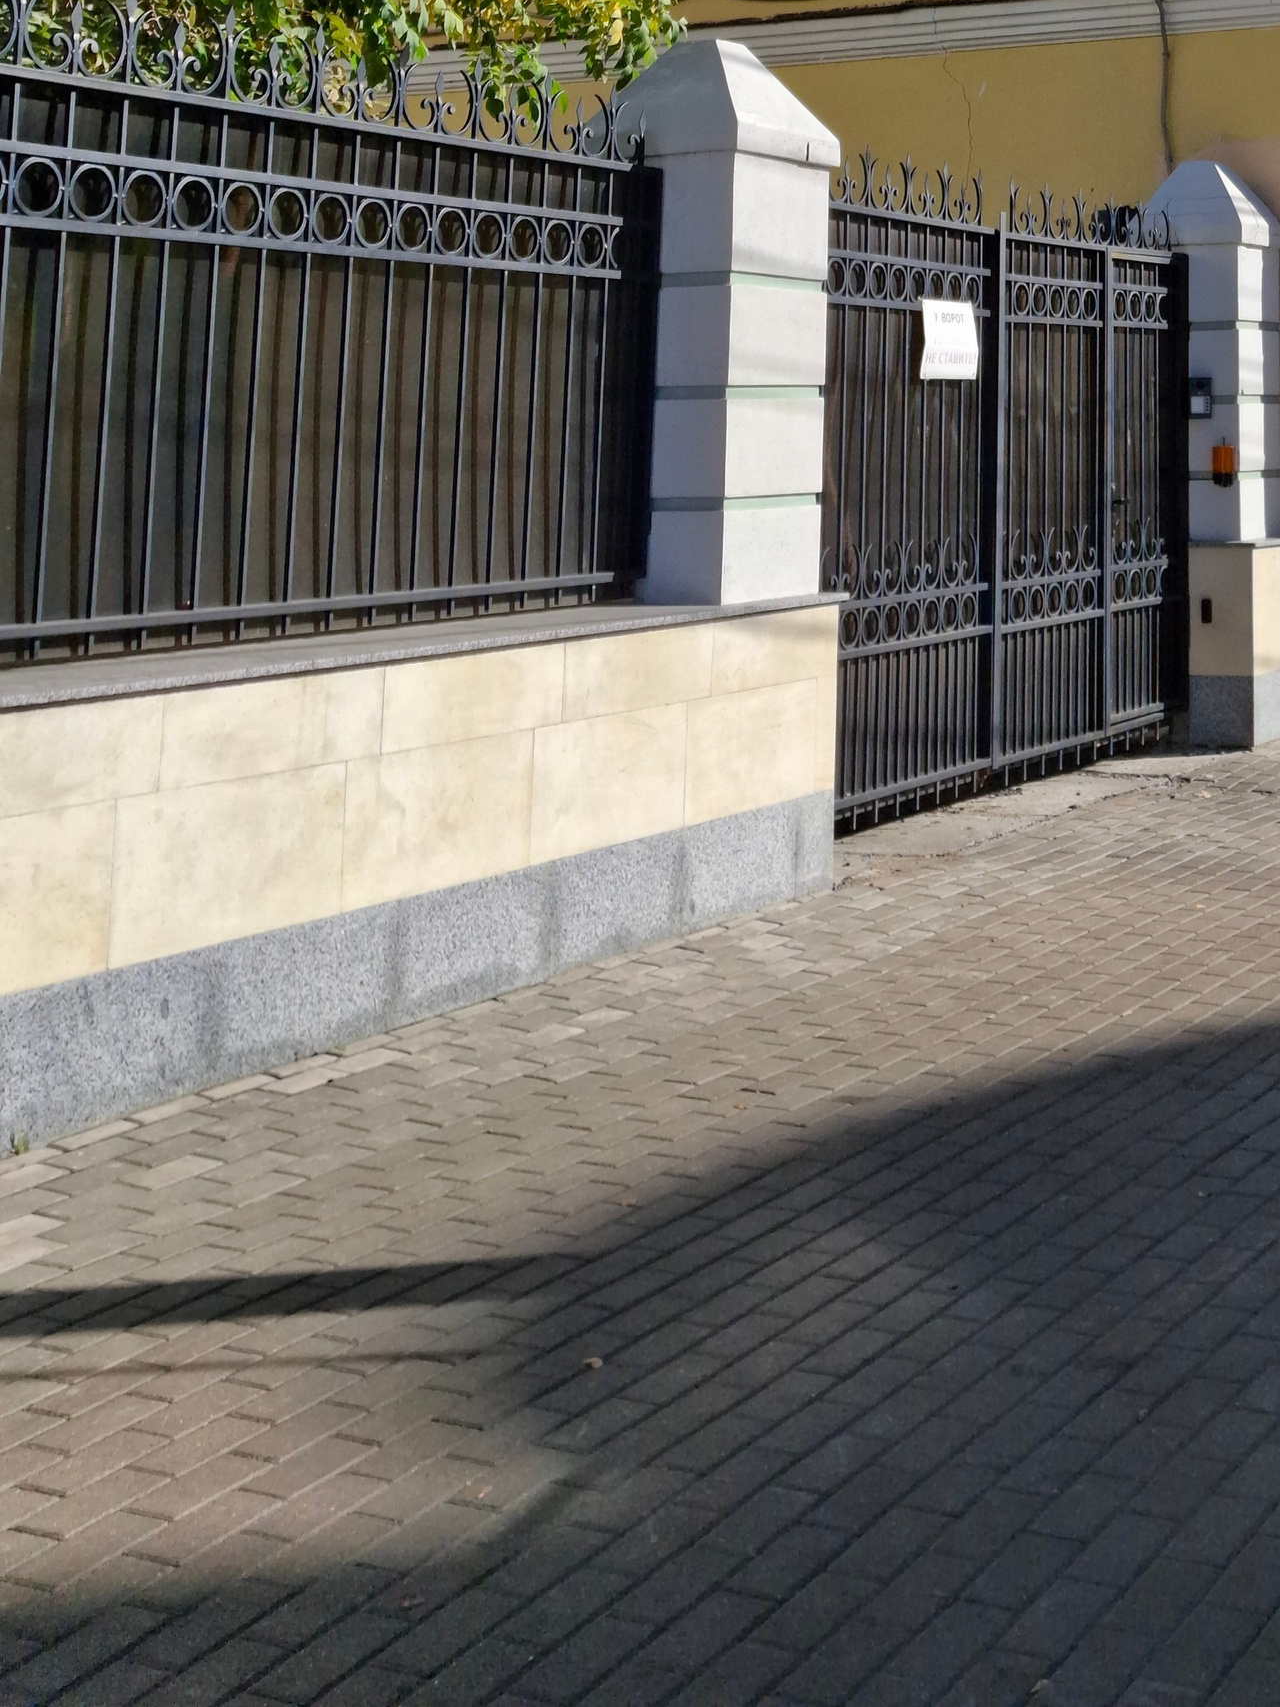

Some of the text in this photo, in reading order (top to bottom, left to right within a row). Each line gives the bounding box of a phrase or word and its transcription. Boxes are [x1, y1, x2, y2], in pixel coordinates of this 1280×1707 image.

[933, 312, 964, 324] У ВОРОТ
[925, 351, 937, 364] НЕ
